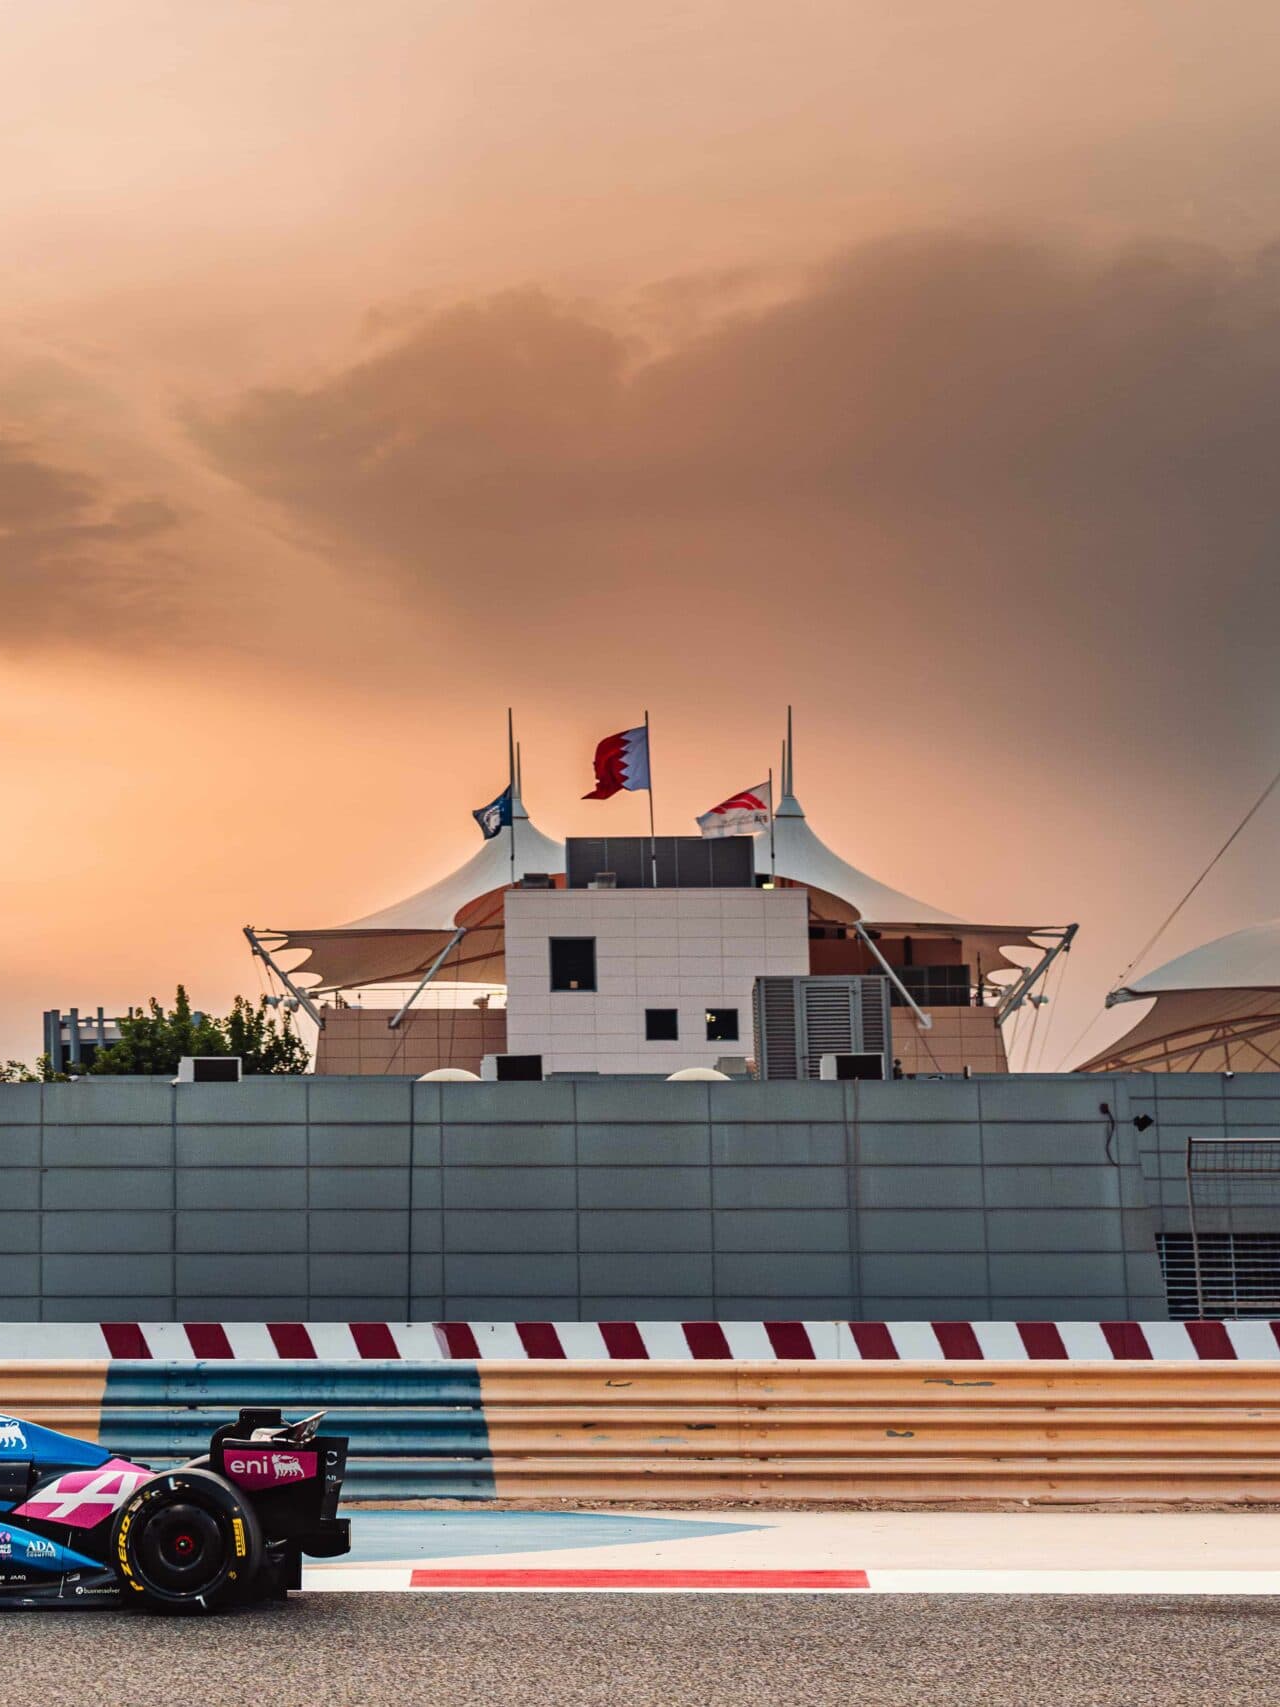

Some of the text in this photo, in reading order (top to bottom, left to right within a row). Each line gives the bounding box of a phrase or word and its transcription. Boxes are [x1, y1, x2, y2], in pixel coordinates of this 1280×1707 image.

[230, 1456, 268, 1474] eni
[26, 1540, 56, 1552] ADA
[118, 1515, 133, 1577] ZERO
